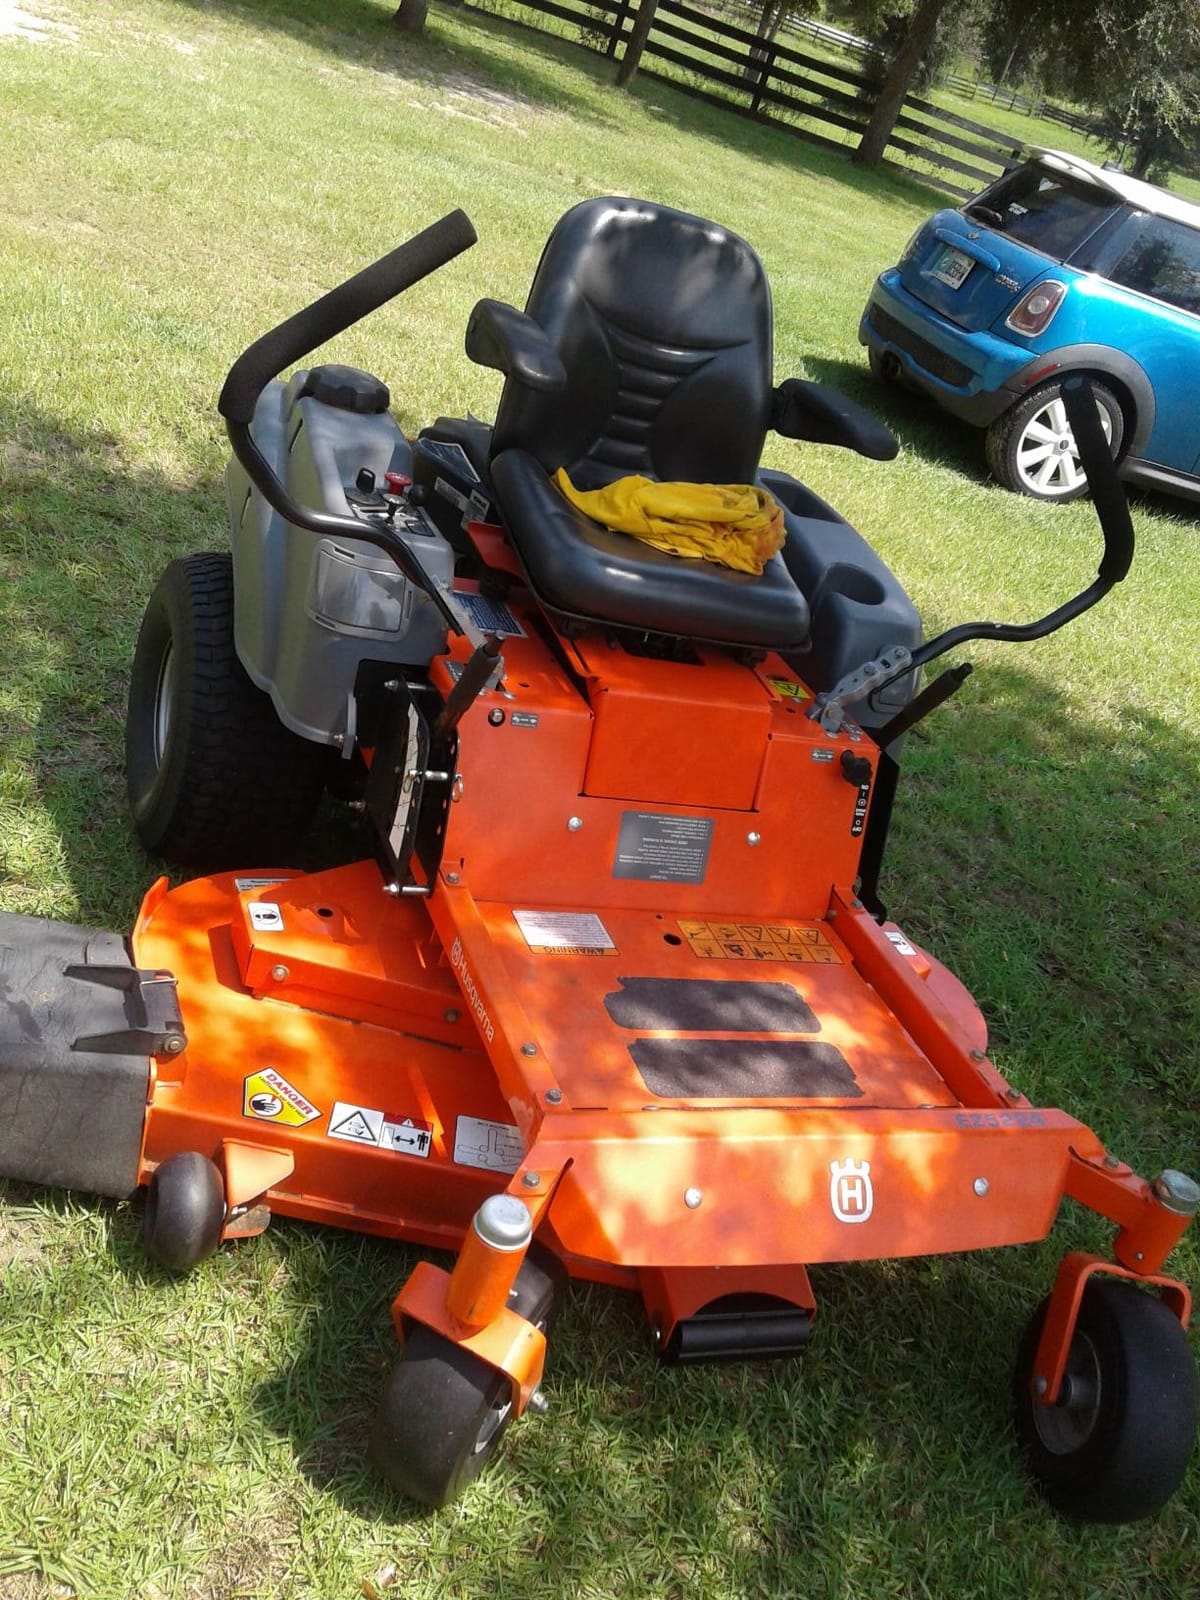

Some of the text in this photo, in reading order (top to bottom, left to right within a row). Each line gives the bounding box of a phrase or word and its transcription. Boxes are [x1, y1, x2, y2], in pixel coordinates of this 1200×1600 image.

[544, 946, 595, 955] WARNING
[458, 955, 495, 1041] Husqvarna
[265, 1073, 314, 1115] DANGER
